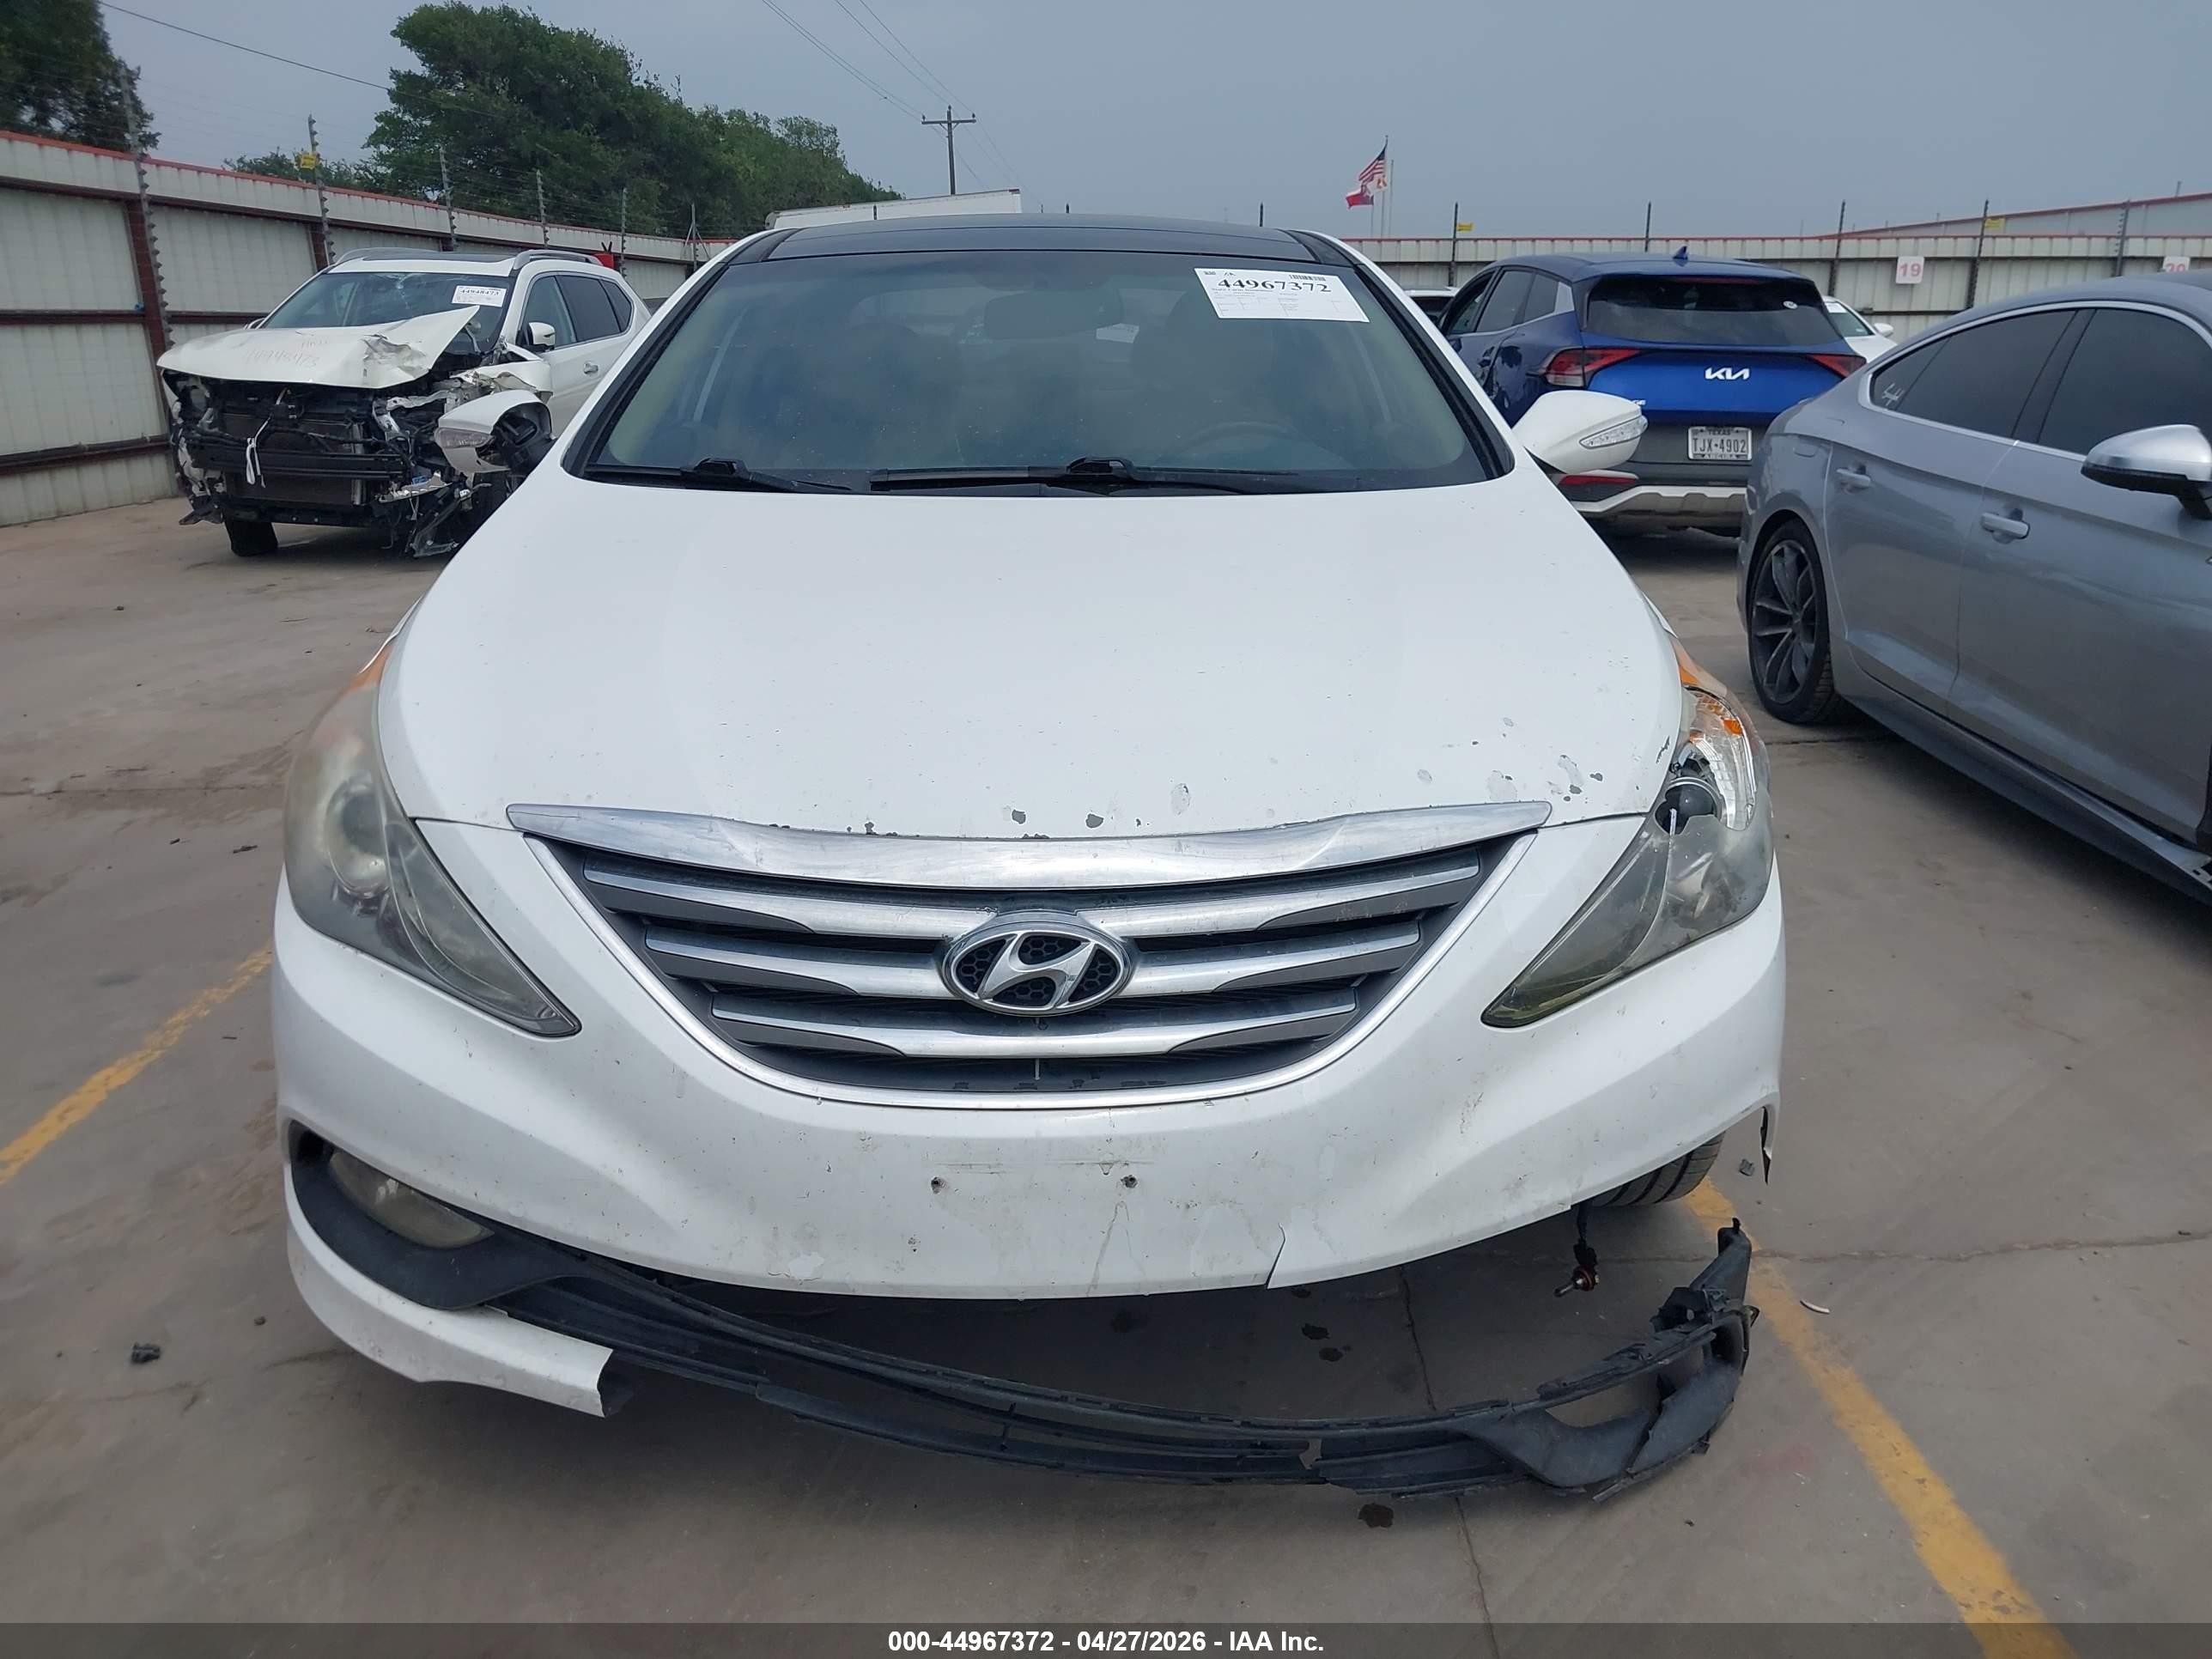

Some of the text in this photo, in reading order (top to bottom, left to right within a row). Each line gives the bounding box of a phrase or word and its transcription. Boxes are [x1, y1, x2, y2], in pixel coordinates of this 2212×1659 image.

[1899, 262, 1922, 276] 19
[1218, 279, 1332, 293] 44967372
[1705, 367, 1750, 380] KIA
